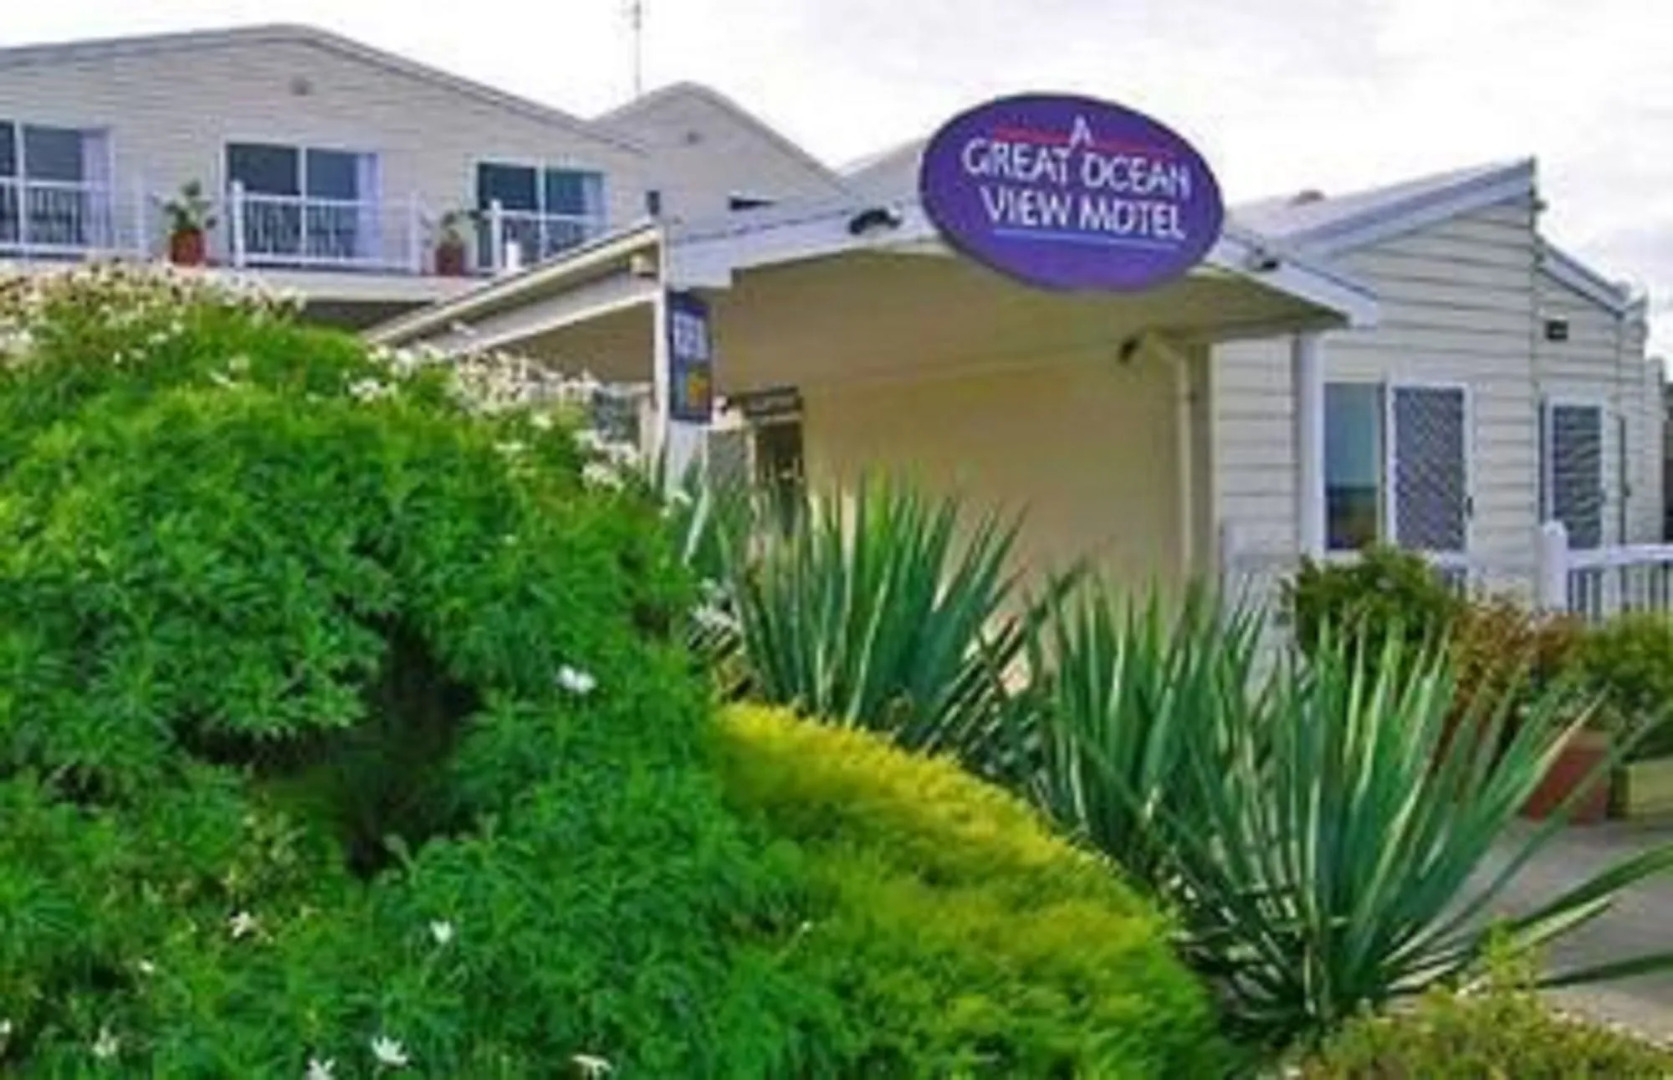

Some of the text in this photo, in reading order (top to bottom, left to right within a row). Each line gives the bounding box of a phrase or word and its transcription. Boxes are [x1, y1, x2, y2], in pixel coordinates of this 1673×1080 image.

[1069, 114, 1094, 148] A
[962, 138, 1191, 198] GREAT OCEAN
[980, 186, 1186, 239] VIEW MOTEL
